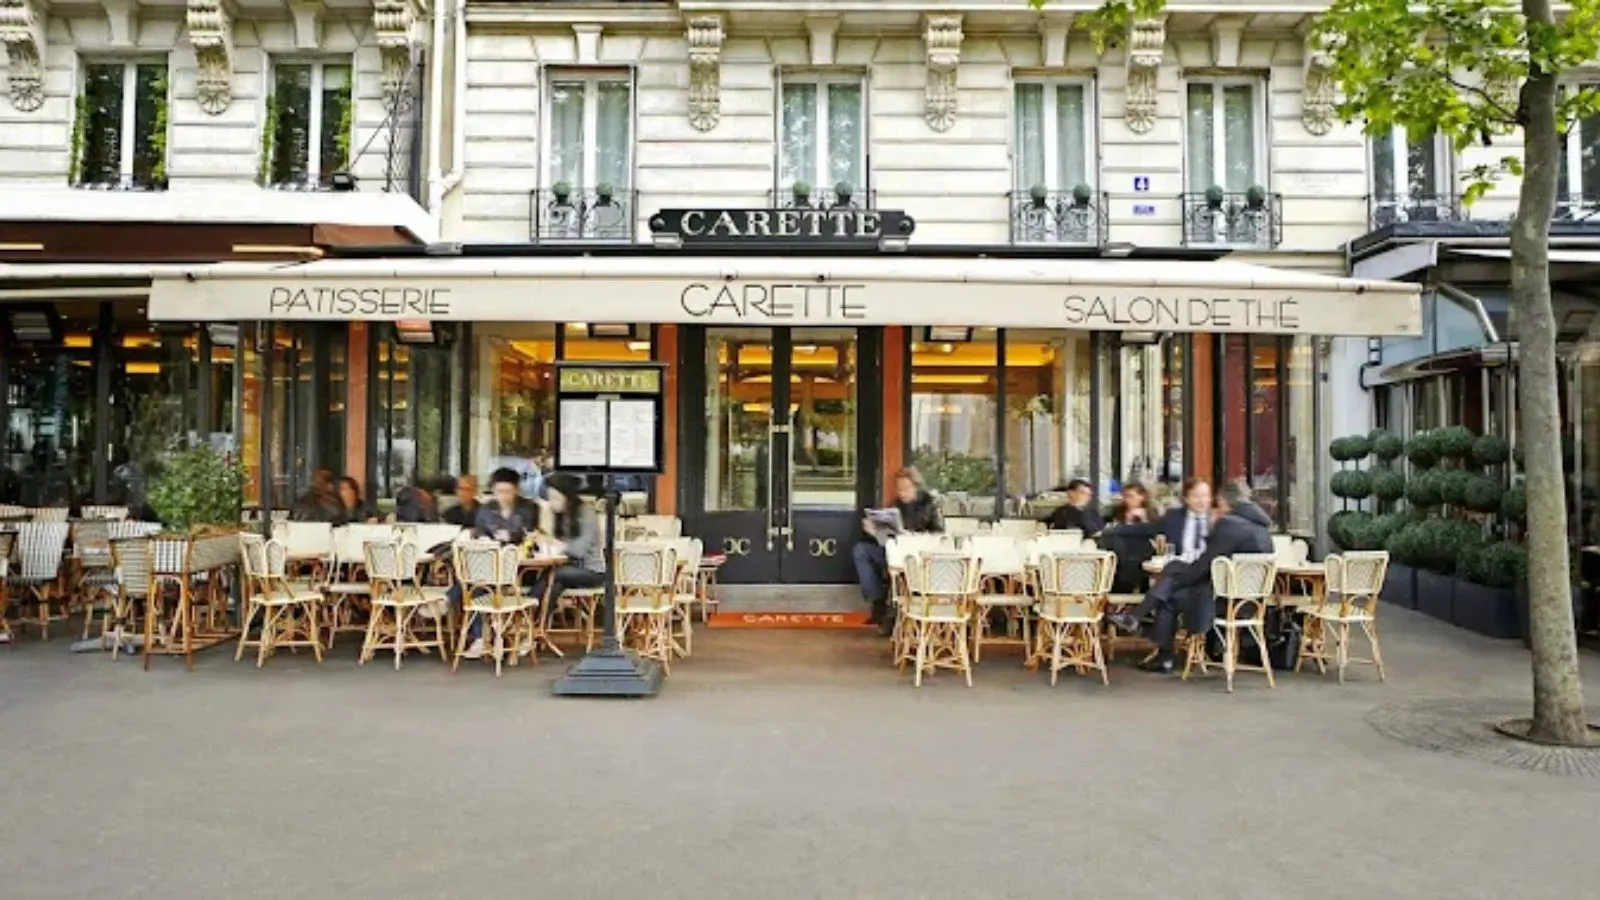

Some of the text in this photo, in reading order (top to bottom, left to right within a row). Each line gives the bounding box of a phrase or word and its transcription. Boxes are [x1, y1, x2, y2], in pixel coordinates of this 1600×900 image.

[680, 210, 882, 237] CARETTE
[270, 287, 451, 314] PATISSERIE
[681, 283, 866, 318] CARETTE
[1063, 295, 1299, 328] SALON DE THÉ
[742, 613, 844, 624] CARETTE
